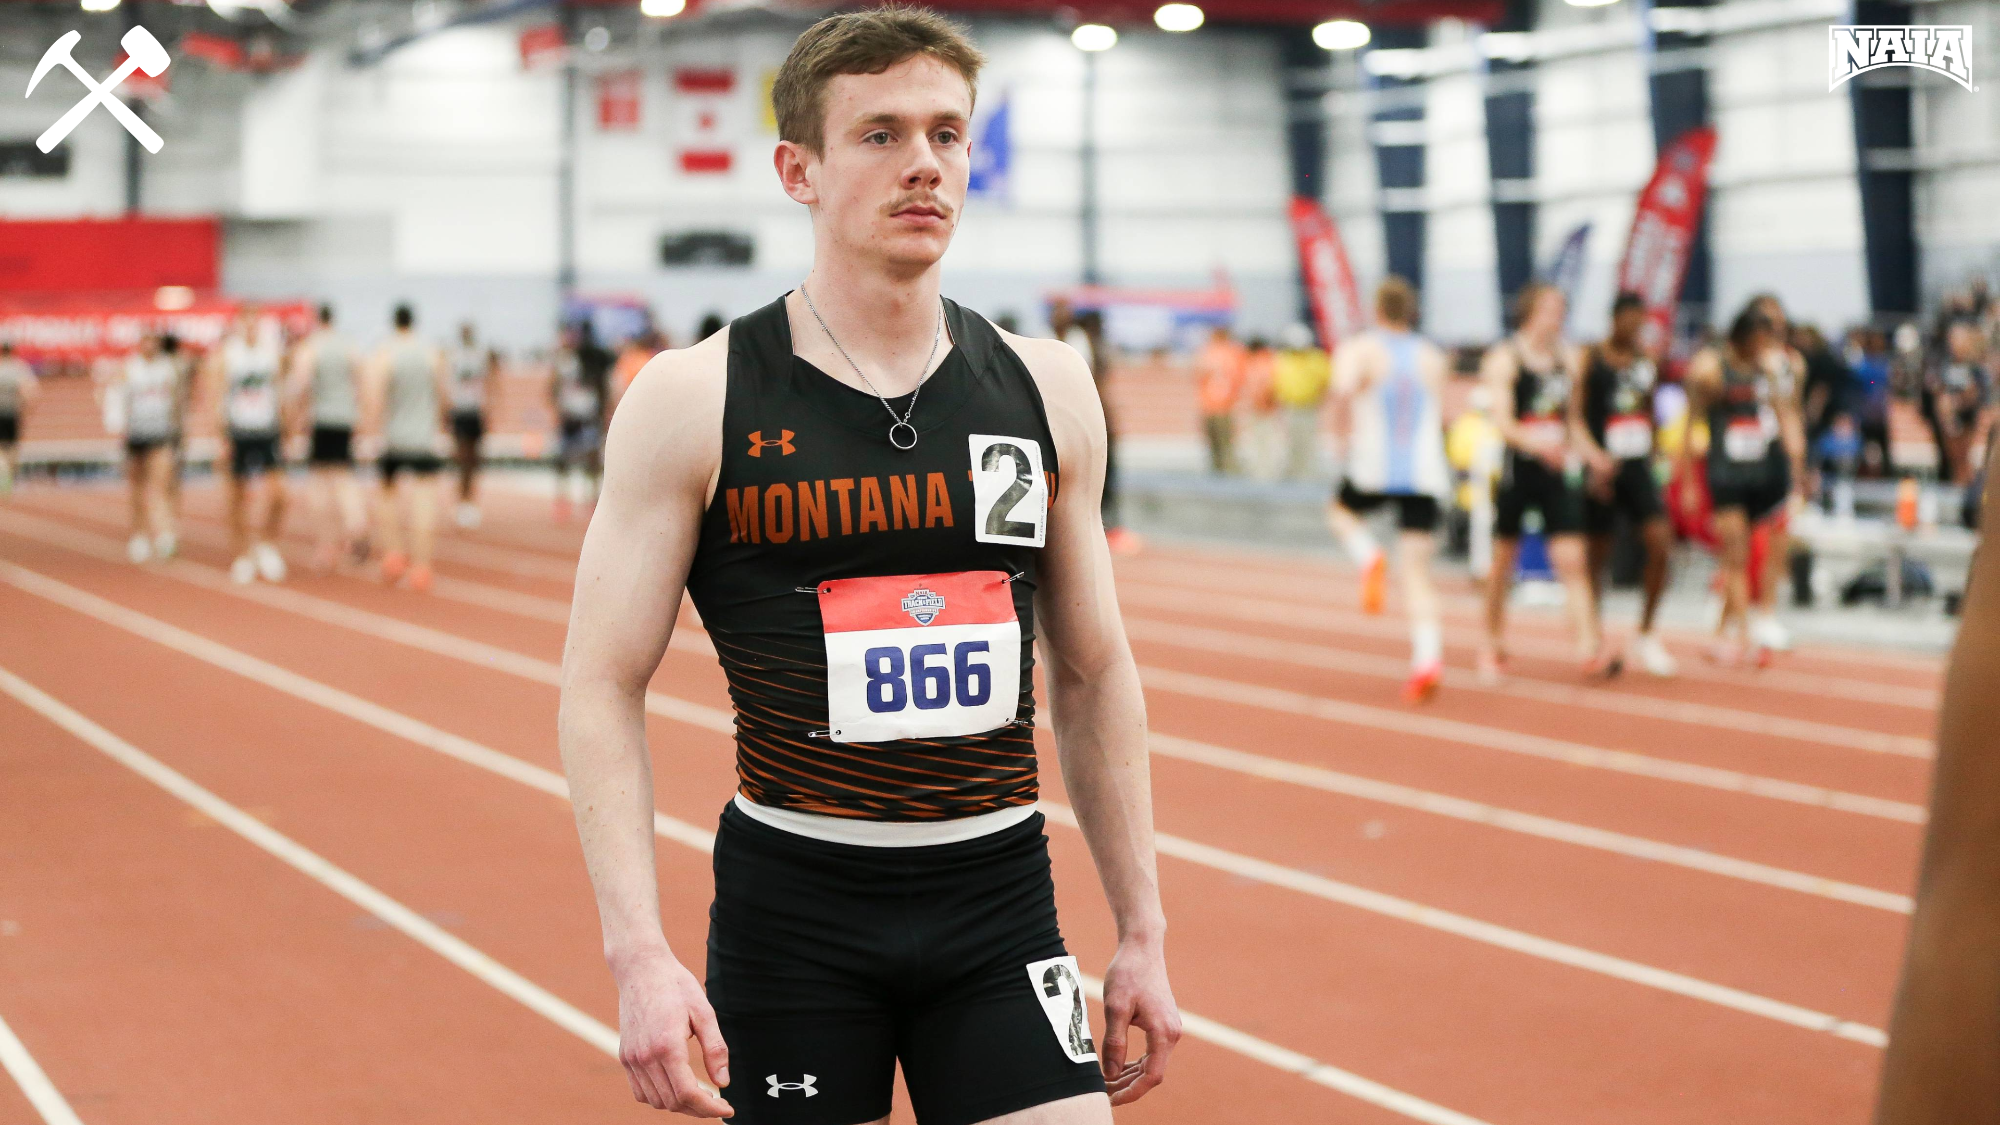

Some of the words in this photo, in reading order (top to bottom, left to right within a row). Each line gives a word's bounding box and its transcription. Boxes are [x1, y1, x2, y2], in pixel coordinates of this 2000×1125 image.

[726, 472, 954, 544] MONTANA
[982, 443, 1036, 539] 2
[865, 640, 992, 713] 866
[1043, 964, 1096, 1056] 2
